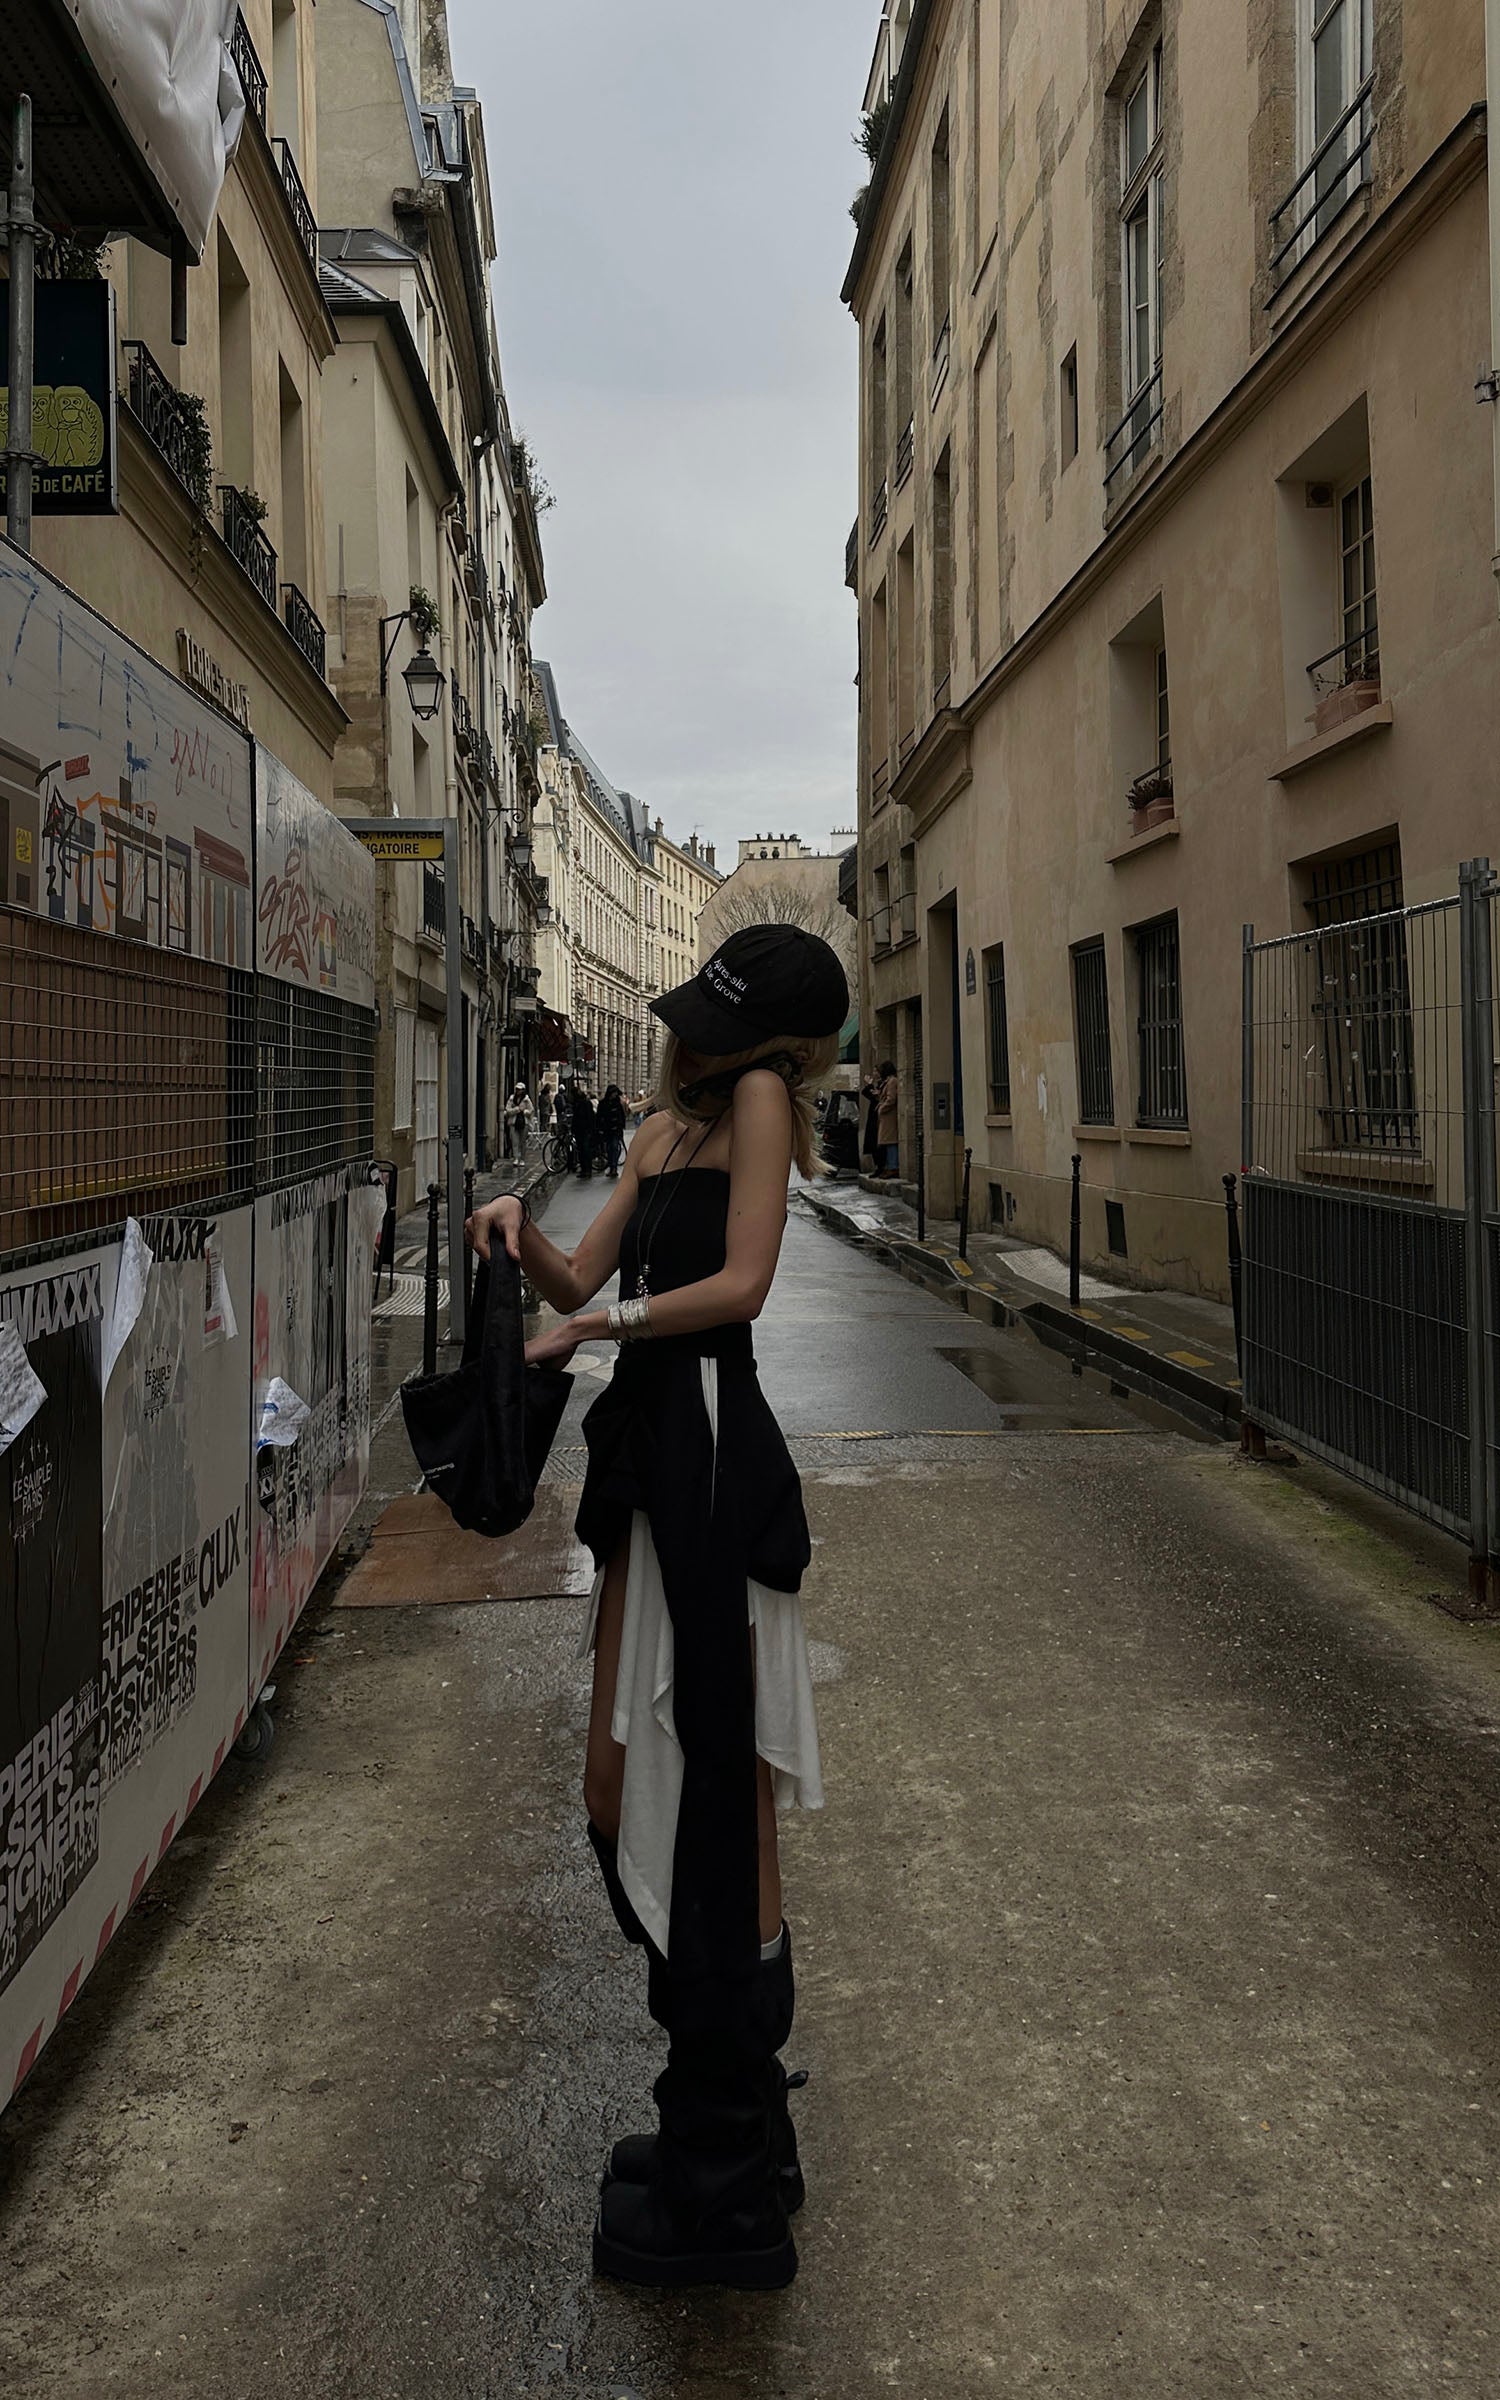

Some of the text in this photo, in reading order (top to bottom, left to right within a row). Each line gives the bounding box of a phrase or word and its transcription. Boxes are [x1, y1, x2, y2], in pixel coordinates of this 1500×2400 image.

[42, 479, 60, 493] DE
[61, 469, 105, 493] CAFÉ
[713, 978, 742, 1005] Grove
[100, 1554, 181, 1659] FRIPERIE
[75, 1686, 99, 1737] XXL
[99, 1624, 197, 1756] DESIGNERS
